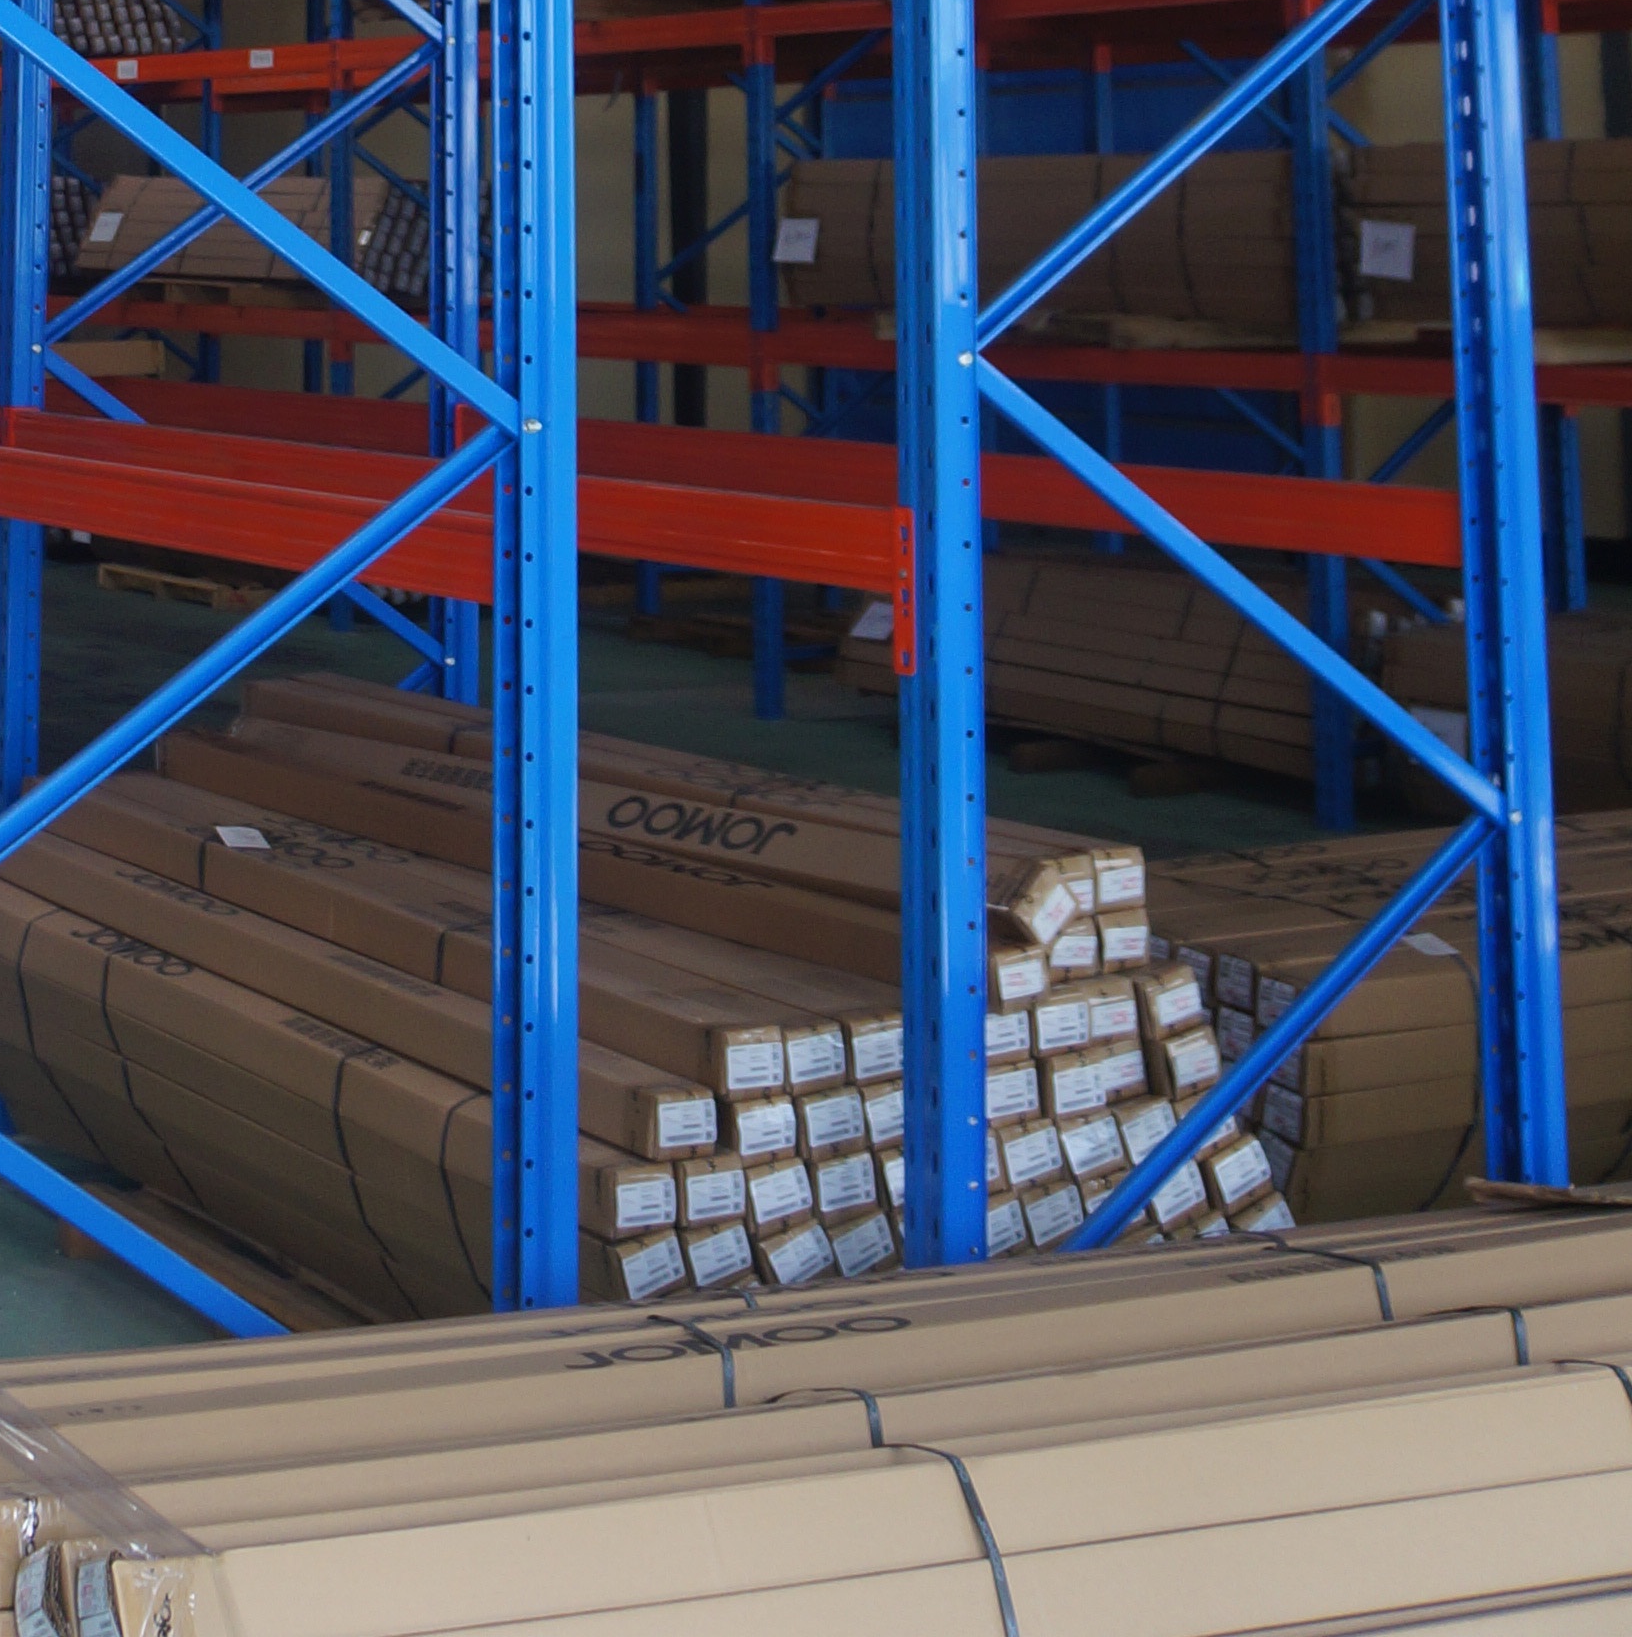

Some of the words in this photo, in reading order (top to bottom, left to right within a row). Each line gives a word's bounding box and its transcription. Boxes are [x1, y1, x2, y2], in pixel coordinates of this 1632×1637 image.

[607, 795, 796, 856] JOMOO
[71, 926, 194, 977] JOMOO
[564, 1315, 912, 1370] JOMOO
